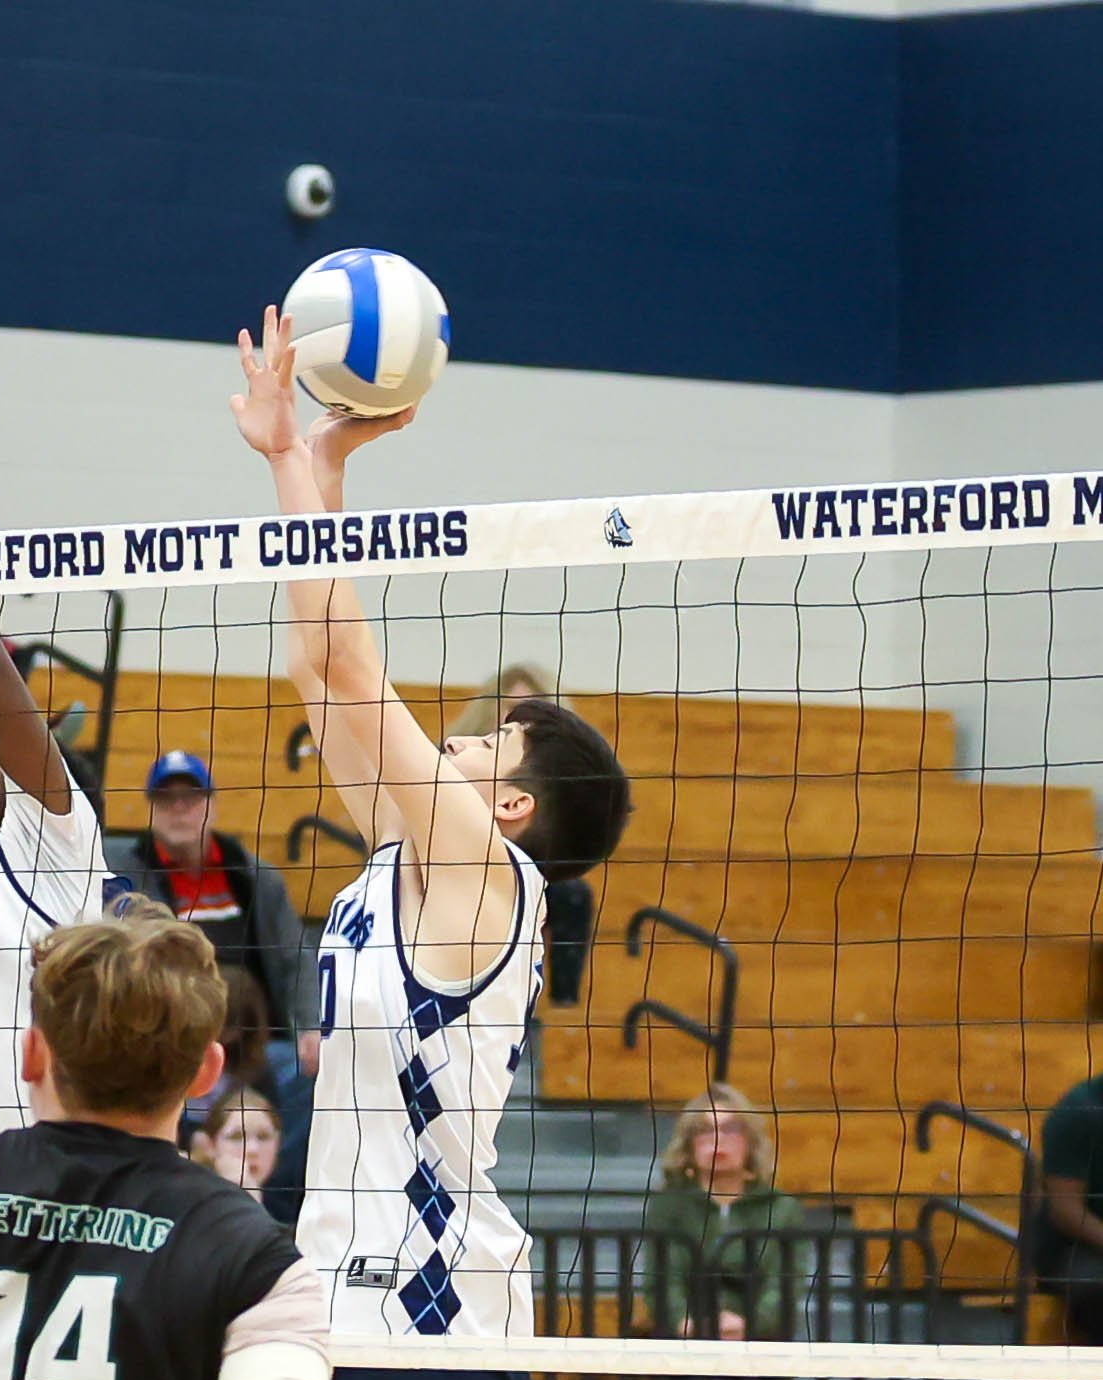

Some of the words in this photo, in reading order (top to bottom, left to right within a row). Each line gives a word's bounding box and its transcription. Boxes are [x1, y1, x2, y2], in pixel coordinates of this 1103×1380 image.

[771, 480, 1050, 540] WATERFORD
[124, 524, 241, 574] MOTT
[259, 510, 468, 568] CORSAIRS
